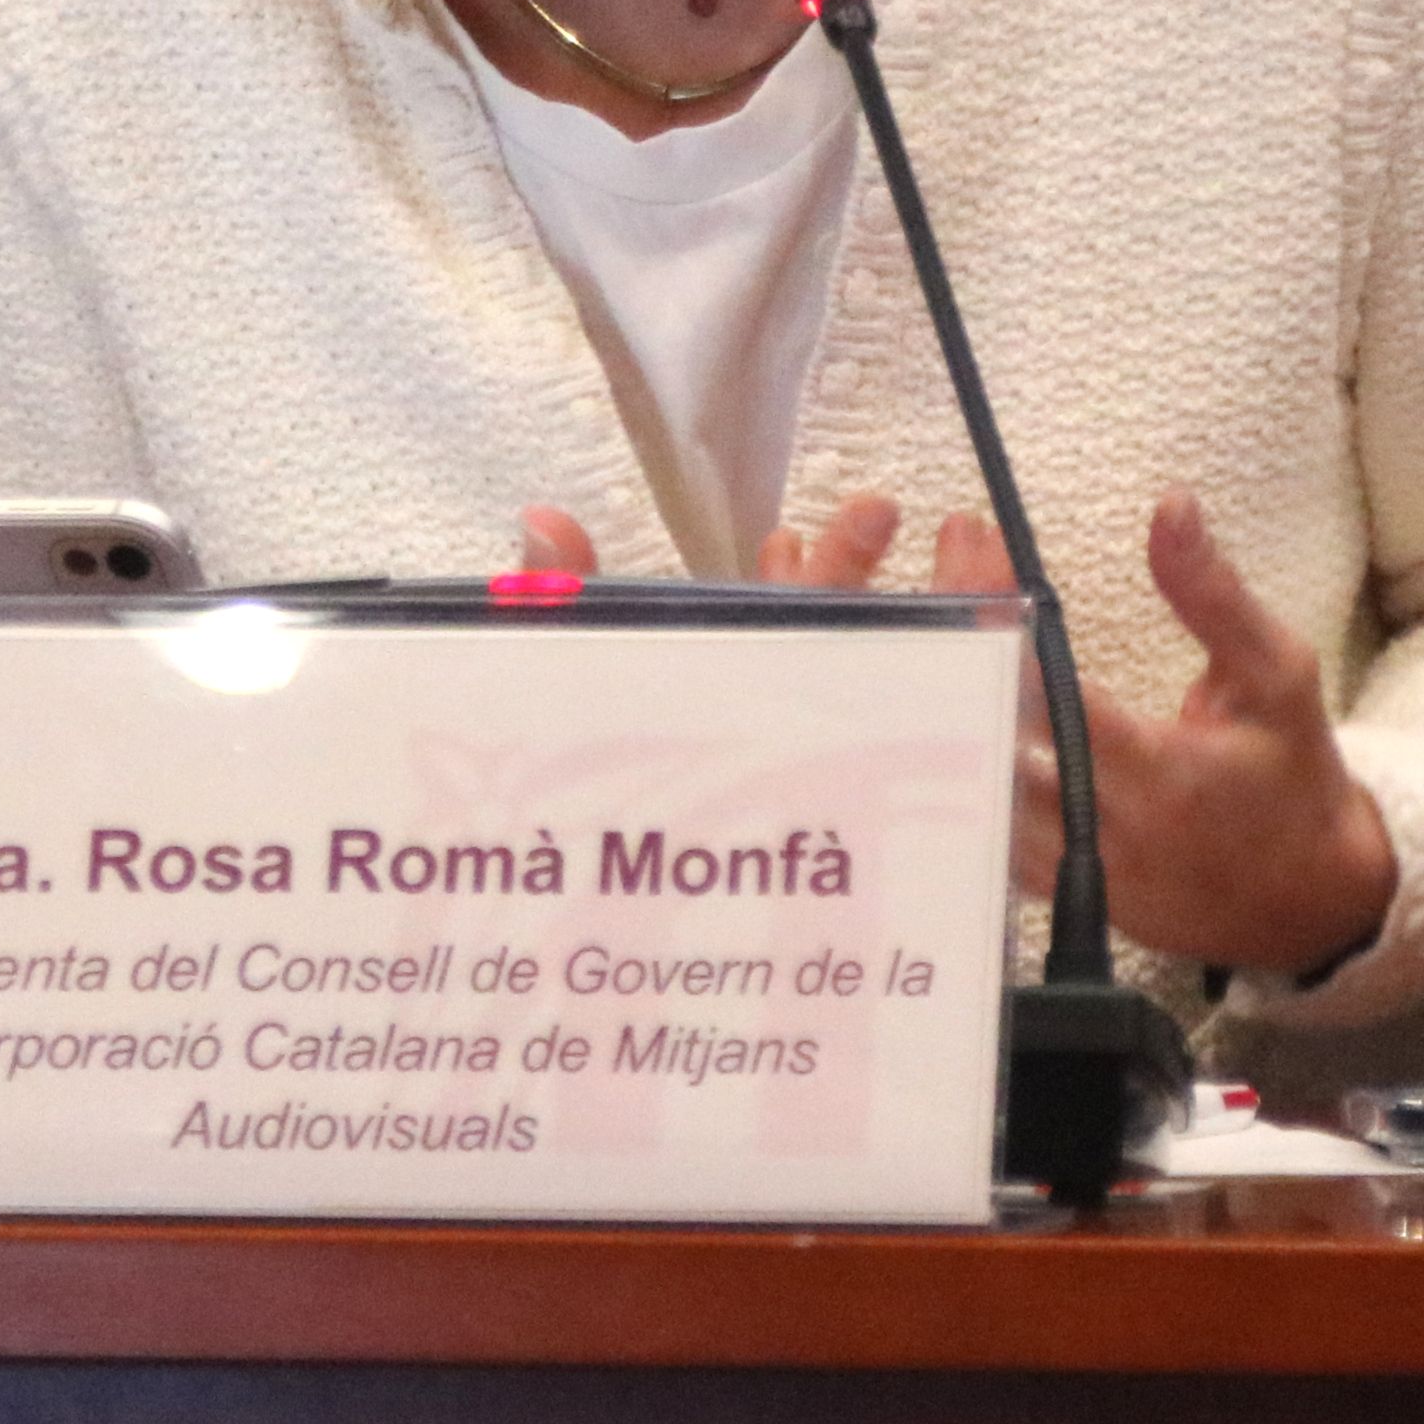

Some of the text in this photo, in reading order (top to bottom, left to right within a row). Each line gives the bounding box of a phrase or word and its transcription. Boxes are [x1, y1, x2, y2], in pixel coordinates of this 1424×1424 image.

[87, 828, 294, 895] Rosa
[327, 827, 566, 895] Romà
[598, 828, 853, 896] Monfà
[130, 944, 218, 994] del
[239, 944, 450, 995] Consell
[472, 944, 539, 995] de
[565, 946, 772, 997] Govern
[794, 947, 862, 997] de
[885, 948, 934, 998] la
[244, 1022, 501, 1073] Catalana
[523, 1023, 589, 1073] de
[612, 1024, 819, 1086] Mitjans
[171, 1101, 538, 1154] Audiovisuals
